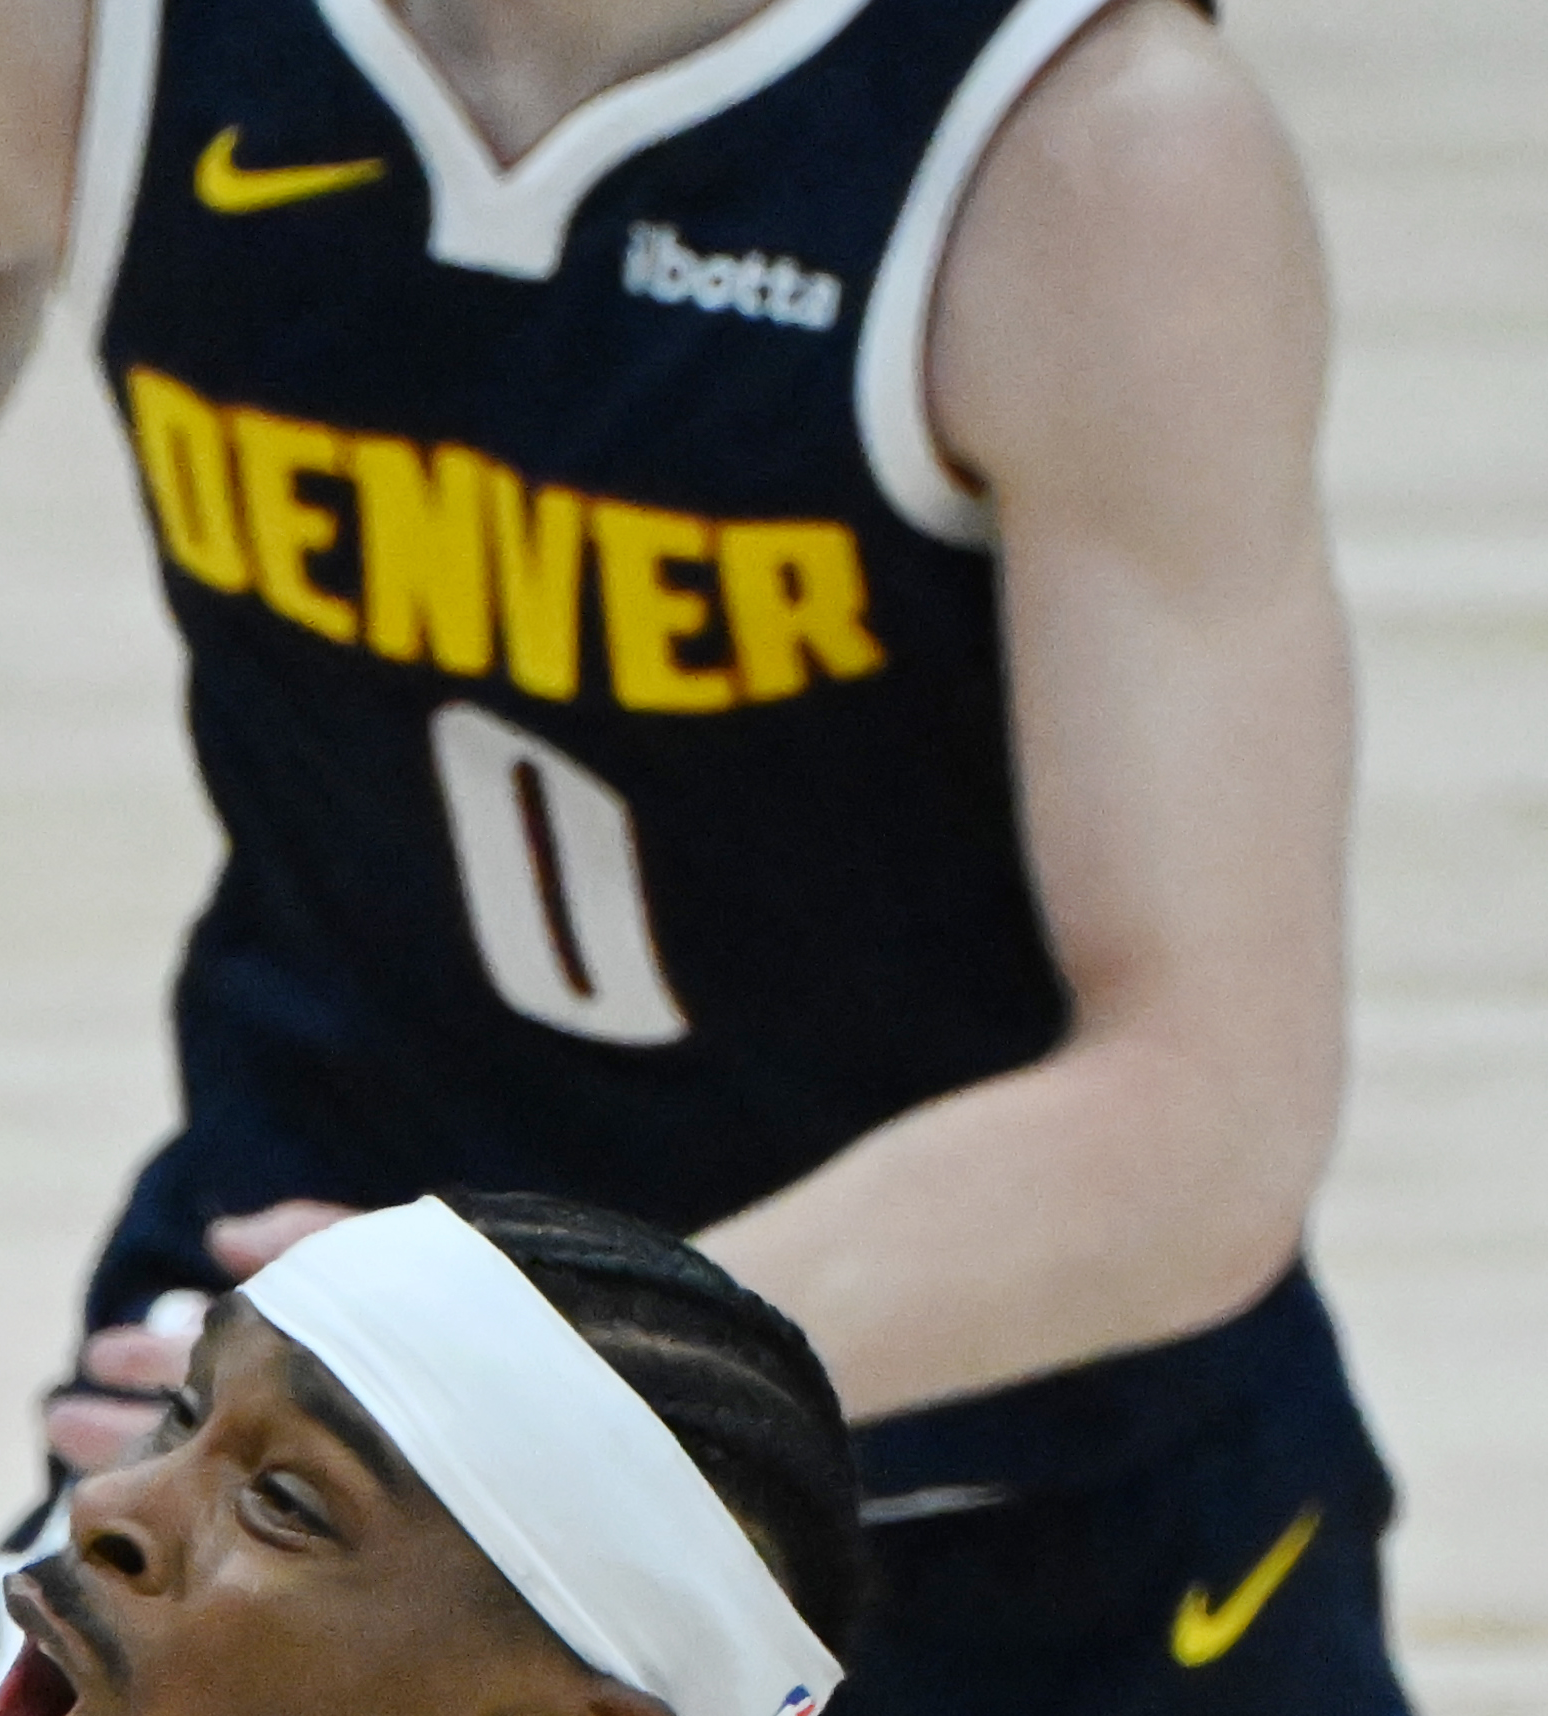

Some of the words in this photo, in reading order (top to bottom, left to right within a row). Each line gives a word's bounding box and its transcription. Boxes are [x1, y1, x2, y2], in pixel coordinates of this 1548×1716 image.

[622, 220, 843, 333] ibotta
[125, 363, 887, 716] DENVER
[430, 702, 691, 1047] 0
